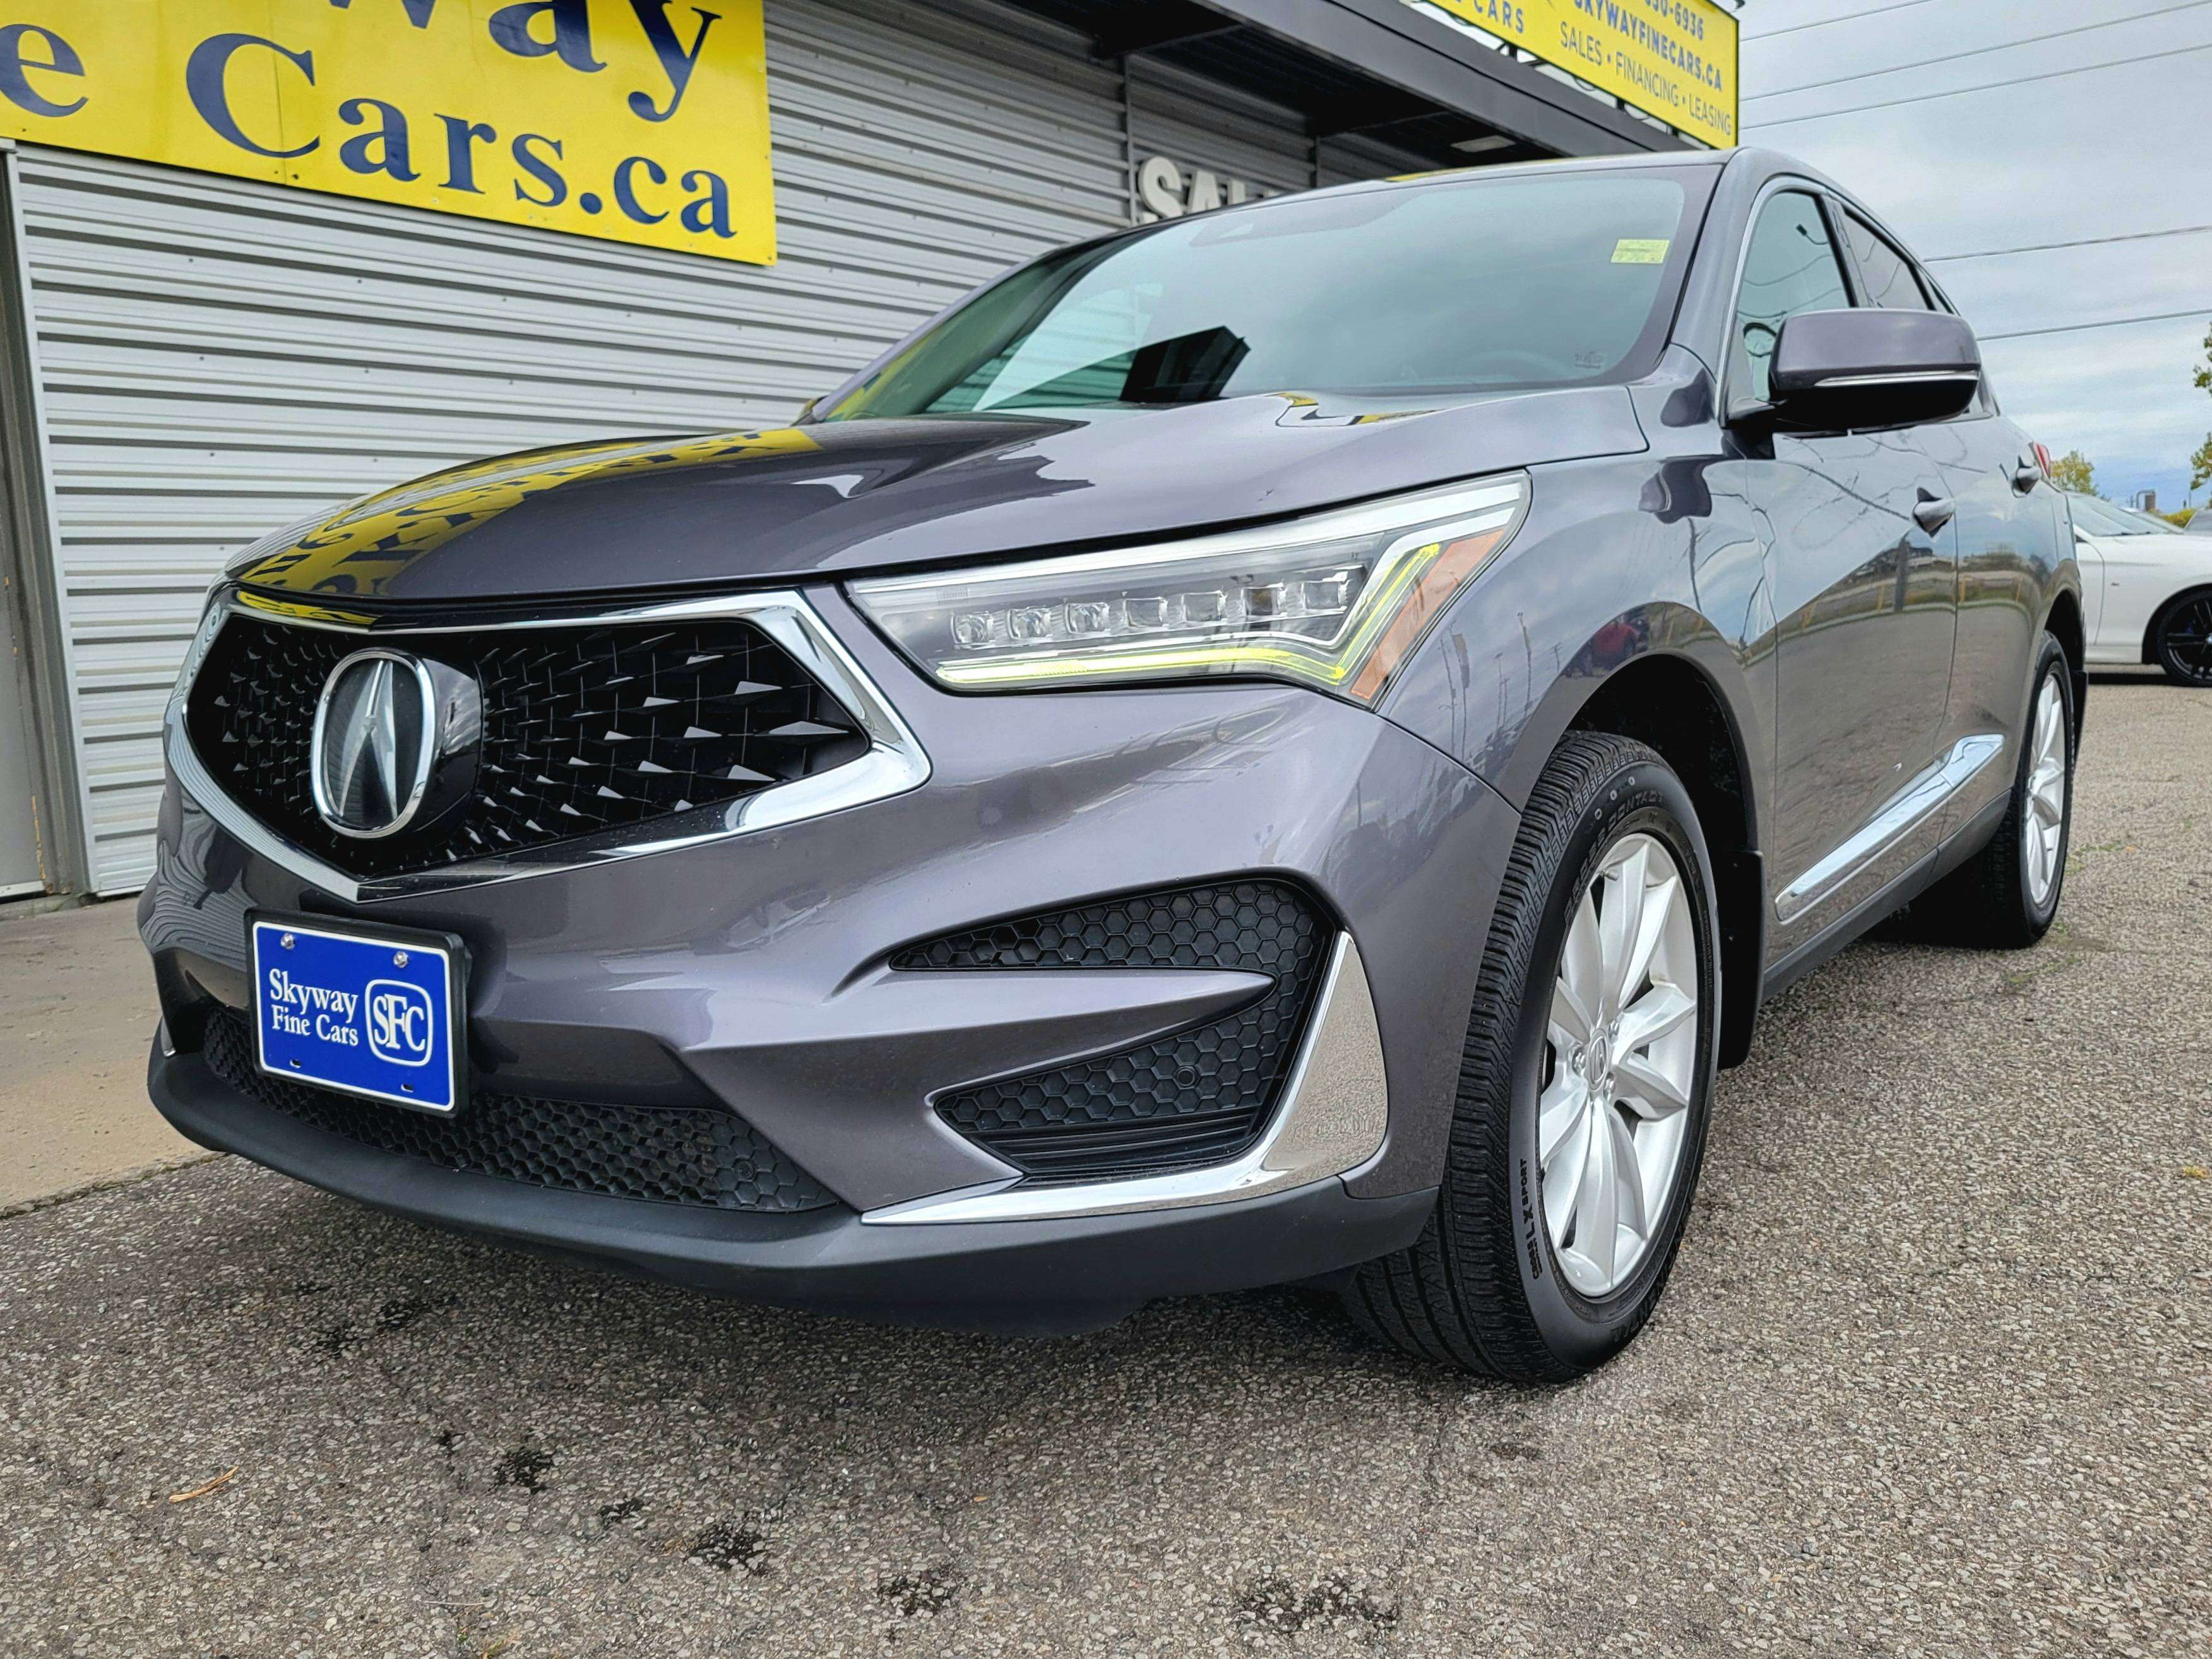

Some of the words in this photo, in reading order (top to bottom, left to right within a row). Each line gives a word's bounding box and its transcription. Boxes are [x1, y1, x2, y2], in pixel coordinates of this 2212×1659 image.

[330, 0, 722, 122] ay
[1560, 21, 1602, 66] SALES
[1615, 52, 1679, 107] FINANCING
[1689, 92, 1732, 136] LEASING
[186, 33, 737, 239] Cars.ca
[269, 968, 359, 1024] Skyway
[373, 994, 426, 1052] SFC
[271, 1004, 311, 1036] Fine
[316, 1014, 359, 1047] Cars
[1520, 1158, 1528, 1206] SPORT
